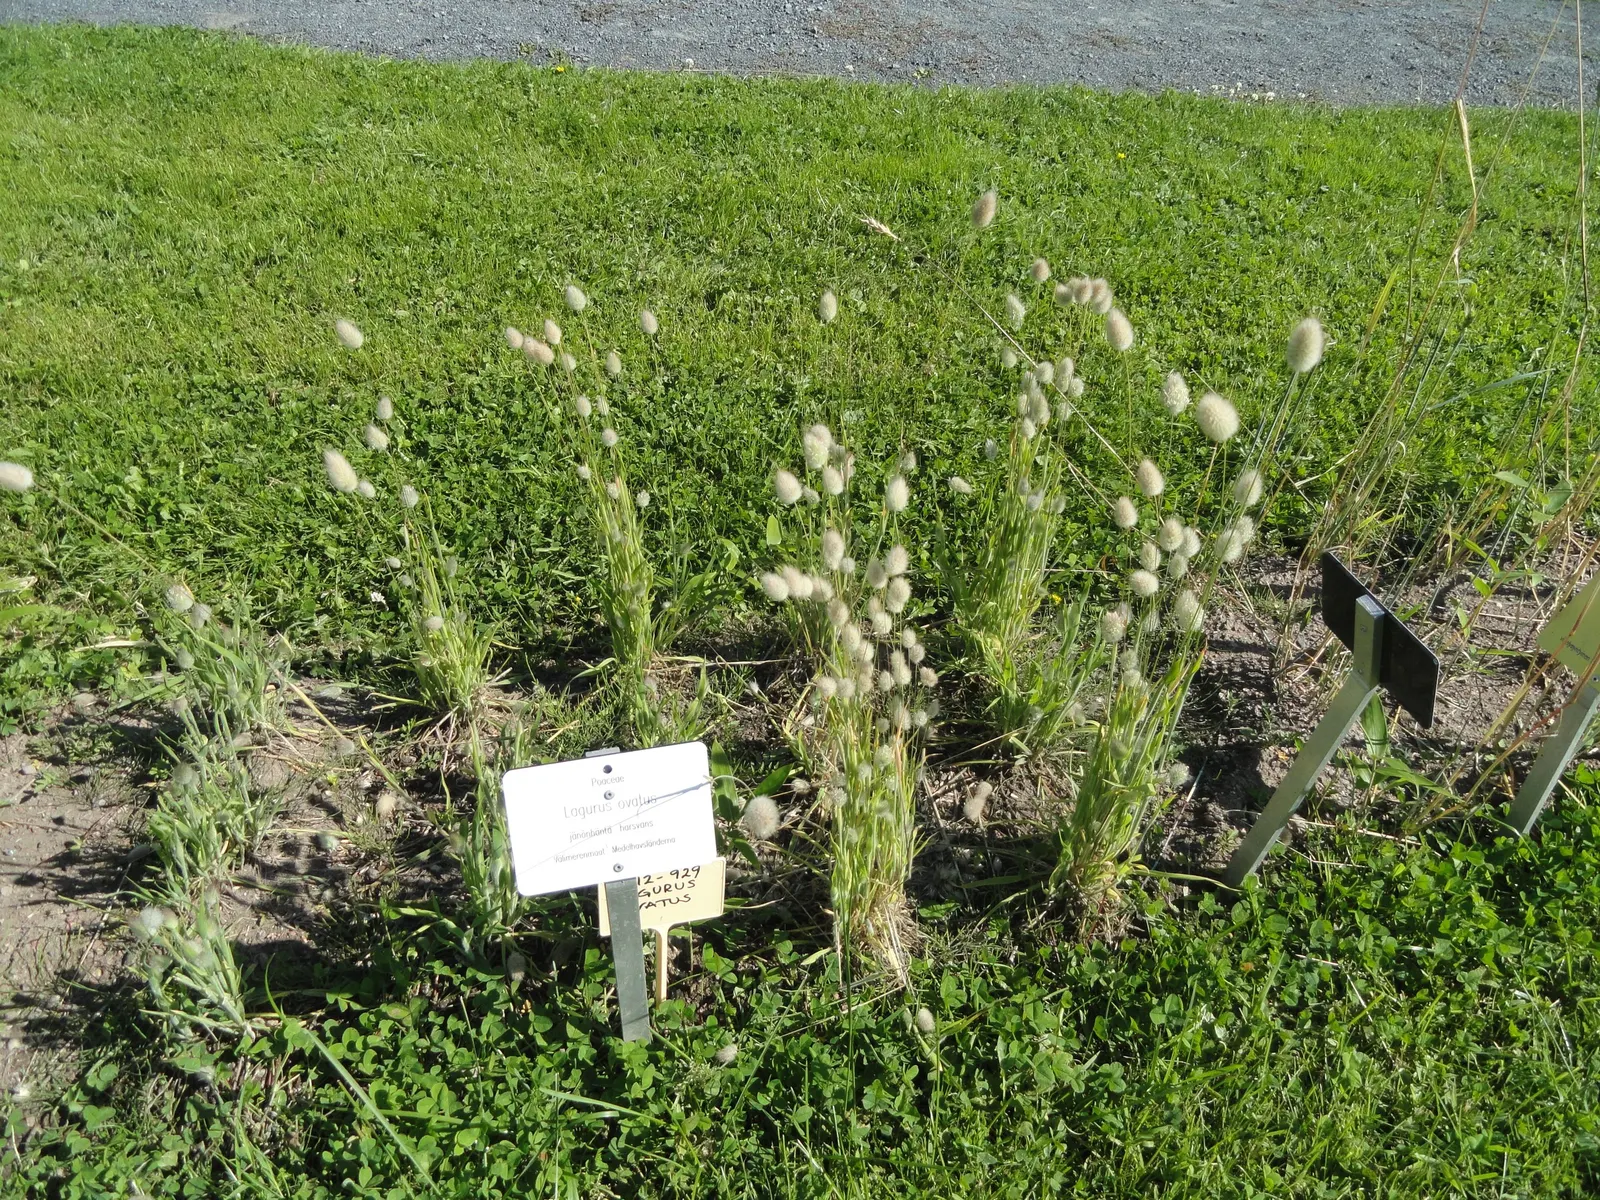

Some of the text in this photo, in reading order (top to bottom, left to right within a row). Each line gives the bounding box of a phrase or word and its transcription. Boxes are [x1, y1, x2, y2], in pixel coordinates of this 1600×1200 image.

[591, 775, 625, 787] Poaceae
[563, 793, 657, 819] Lagurus ovatus
